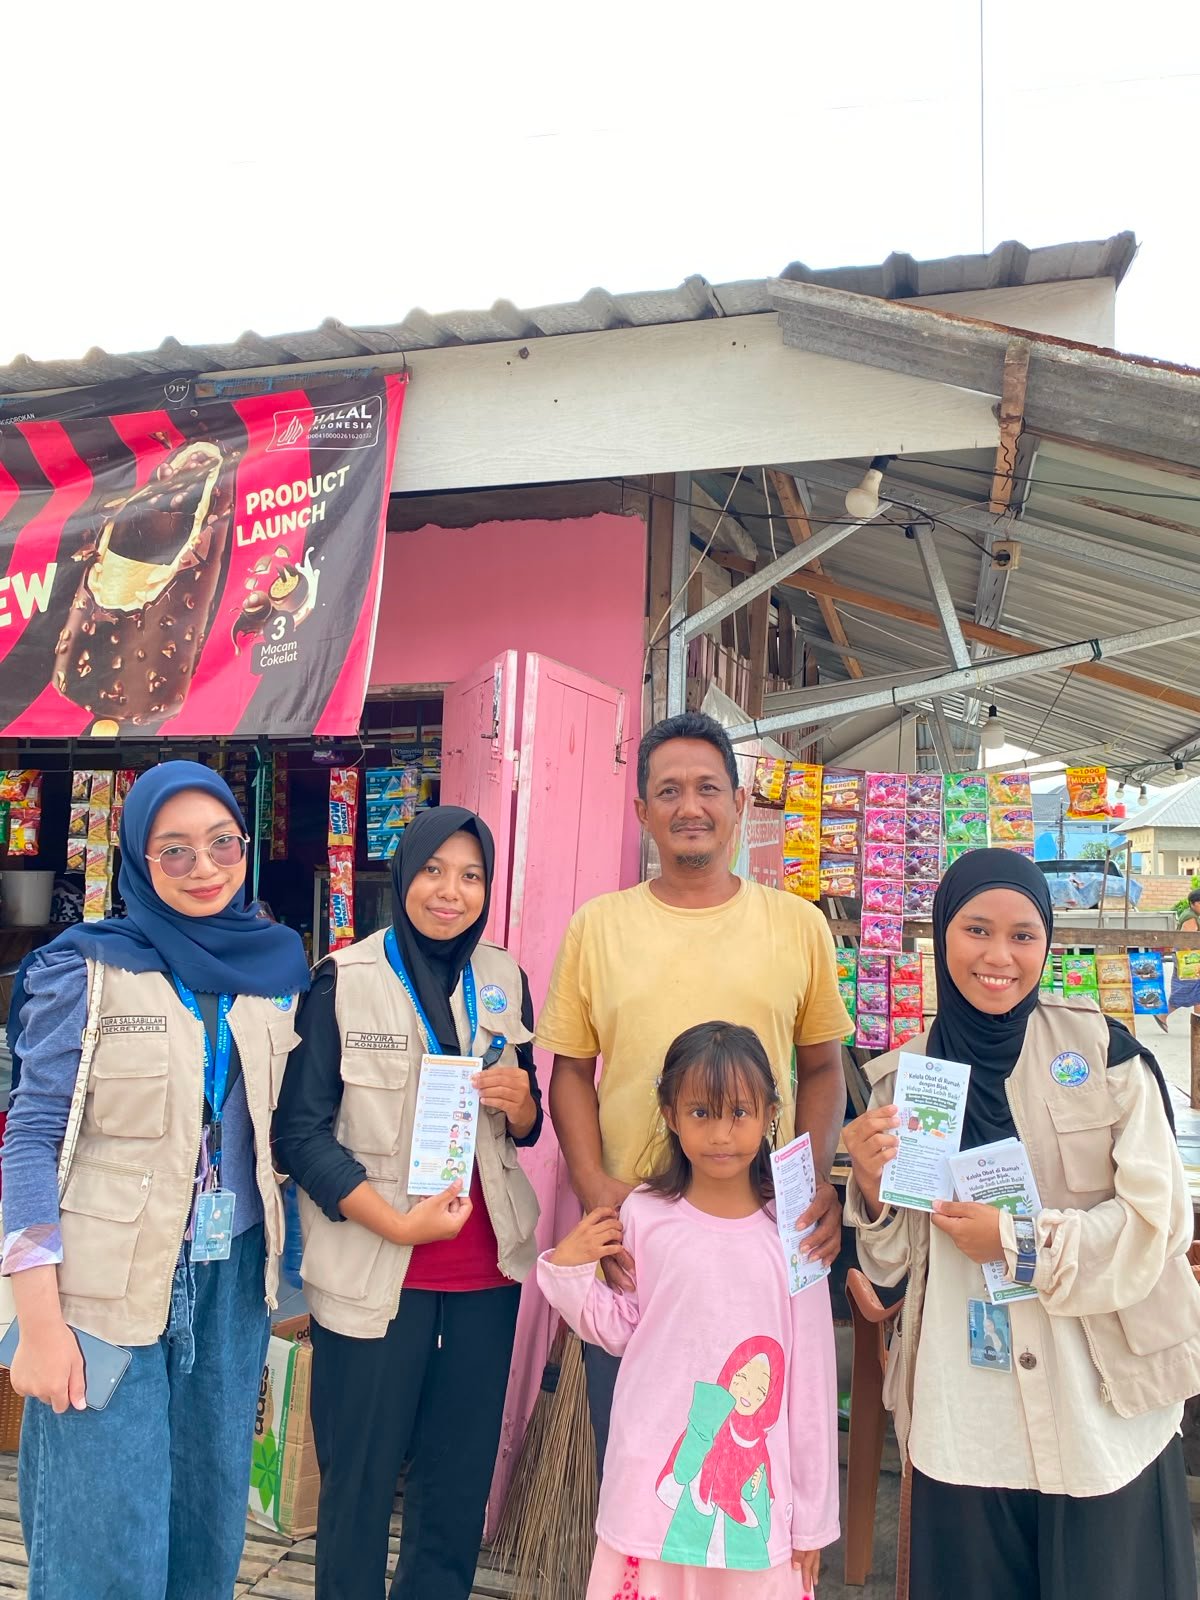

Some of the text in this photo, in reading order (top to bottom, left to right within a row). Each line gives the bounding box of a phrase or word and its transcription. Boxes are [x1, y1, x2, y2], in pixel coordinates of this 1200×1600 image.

[312, 404, 372, 425] HALAL
[308, 422, 373, 432] INDONESIA
[245, 464, 351, 516] PRODUCT
[236, 501, 326, 547] LAUNCH
[272, 616, 287, 641] 3
[260, 640, 298, 657] Macam
[260, 652, 298, 668] Cokelat
[824, 782, 857, 791] ENERGEN
[329, 802, 341, 835] WOW
[823, 824, 855, 833] ENERGEN
[822, 868, 853, 876] ENERGEN
[332, 894, 341, 927] WOW
[106, 1025, 160, 1033] SEKRETARIS
[360, 1034, 394, 1043] NOVIRA
[944, 1078, 960, 1088] Rumah
[934, 1089, 947, 1097] Lebih
[969, 1184, 985, 1192] Hidup
